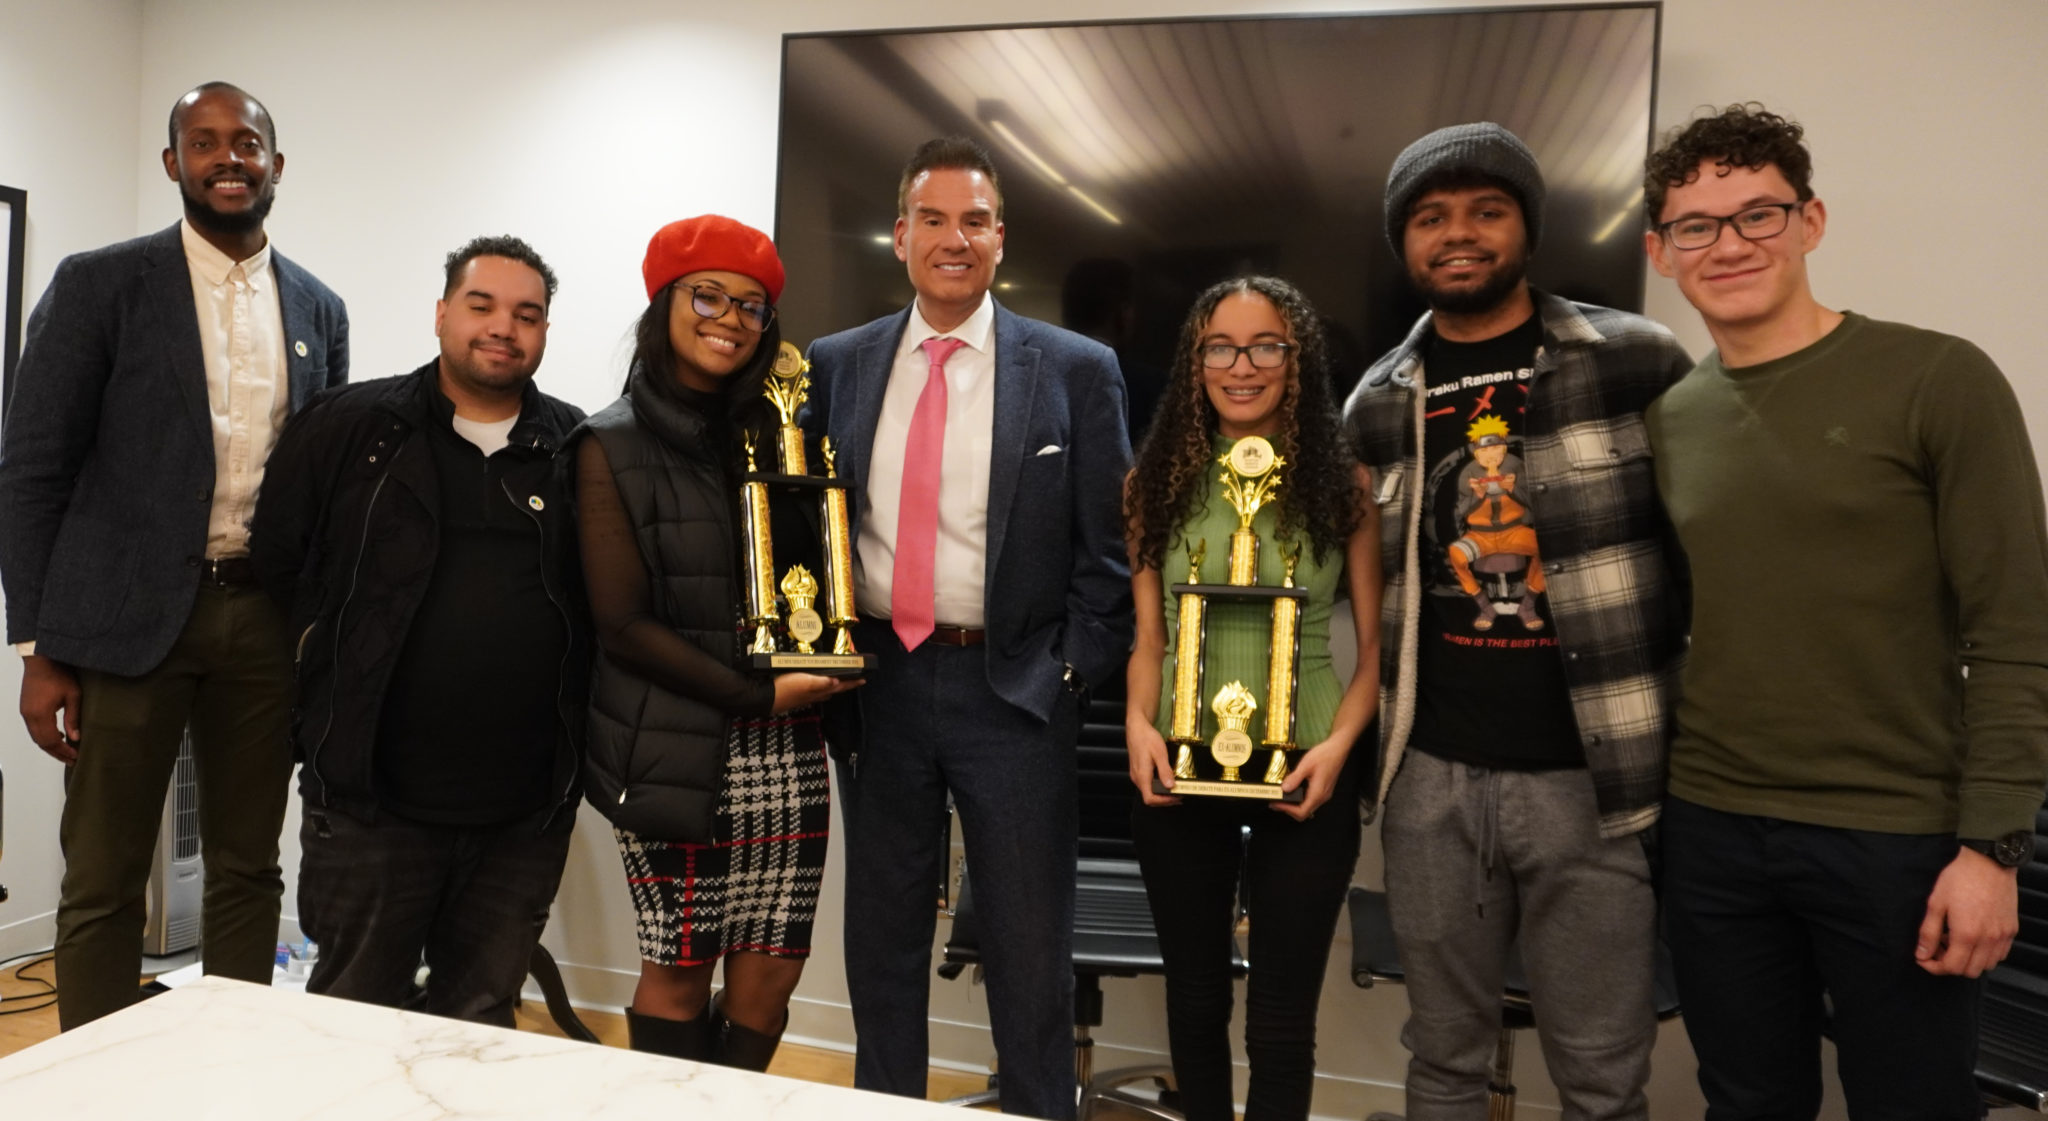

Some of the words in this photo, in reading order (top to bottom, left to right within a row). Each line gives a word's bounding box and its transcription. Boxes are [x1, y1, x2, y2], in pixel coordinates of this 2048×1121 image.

[1425, 380, 1460, 398] raku
[1462, 370, 1513, 388] Ramen
[796, 620, 817, 630] ALUMNI
[1474, 638, 1484, 647] IS
[1487, 638, 1508, 648] THE
[1510, 639, 1537, 648] BEST
